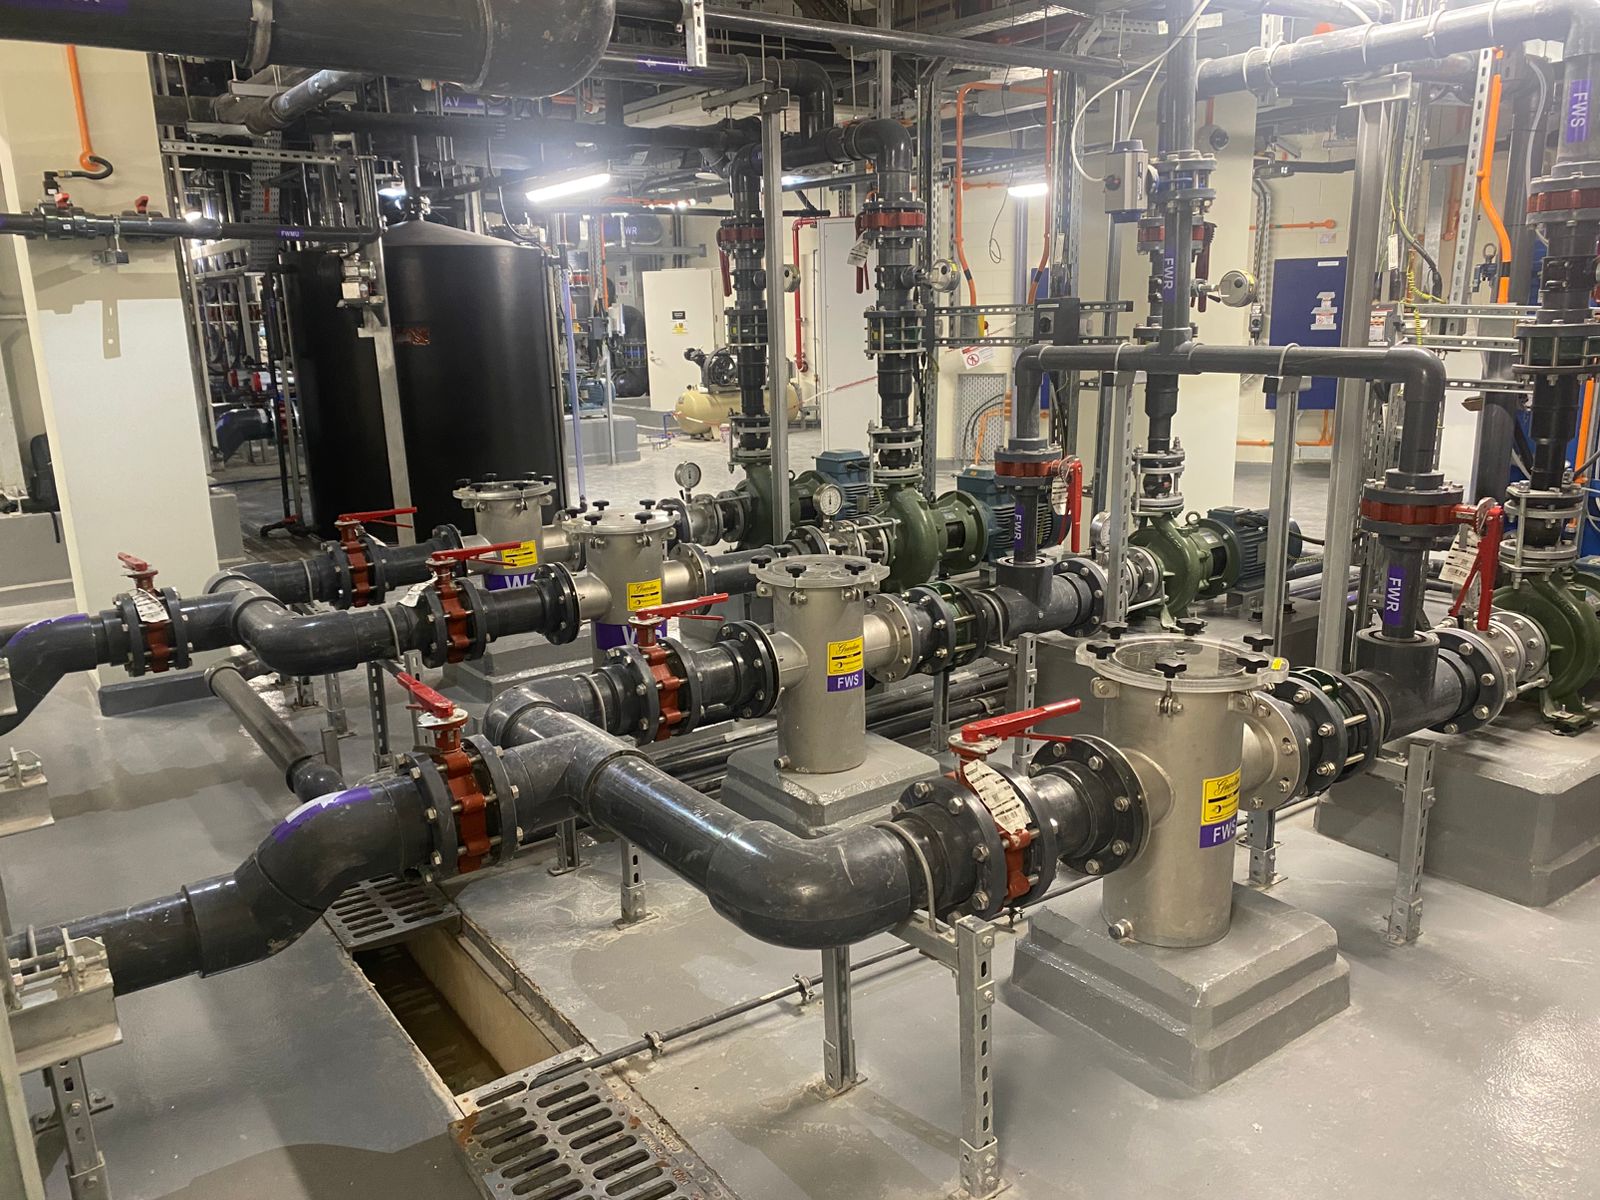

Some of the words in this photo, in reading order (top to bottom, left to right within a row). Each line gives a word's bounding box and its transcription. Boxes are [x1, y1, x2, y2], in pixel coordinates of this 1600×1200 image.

[1570, 92, 1588, 128] FWS
[1163, 257, 1175, 290] FWR
[1014, 514, 1022, 540] FWR
[504, 572, 536, 590] W
[1386, 577, 1402, 612] FWR
[837, 674, 860, 689] FWS
[1213, 818, 1237, 843] FWS
